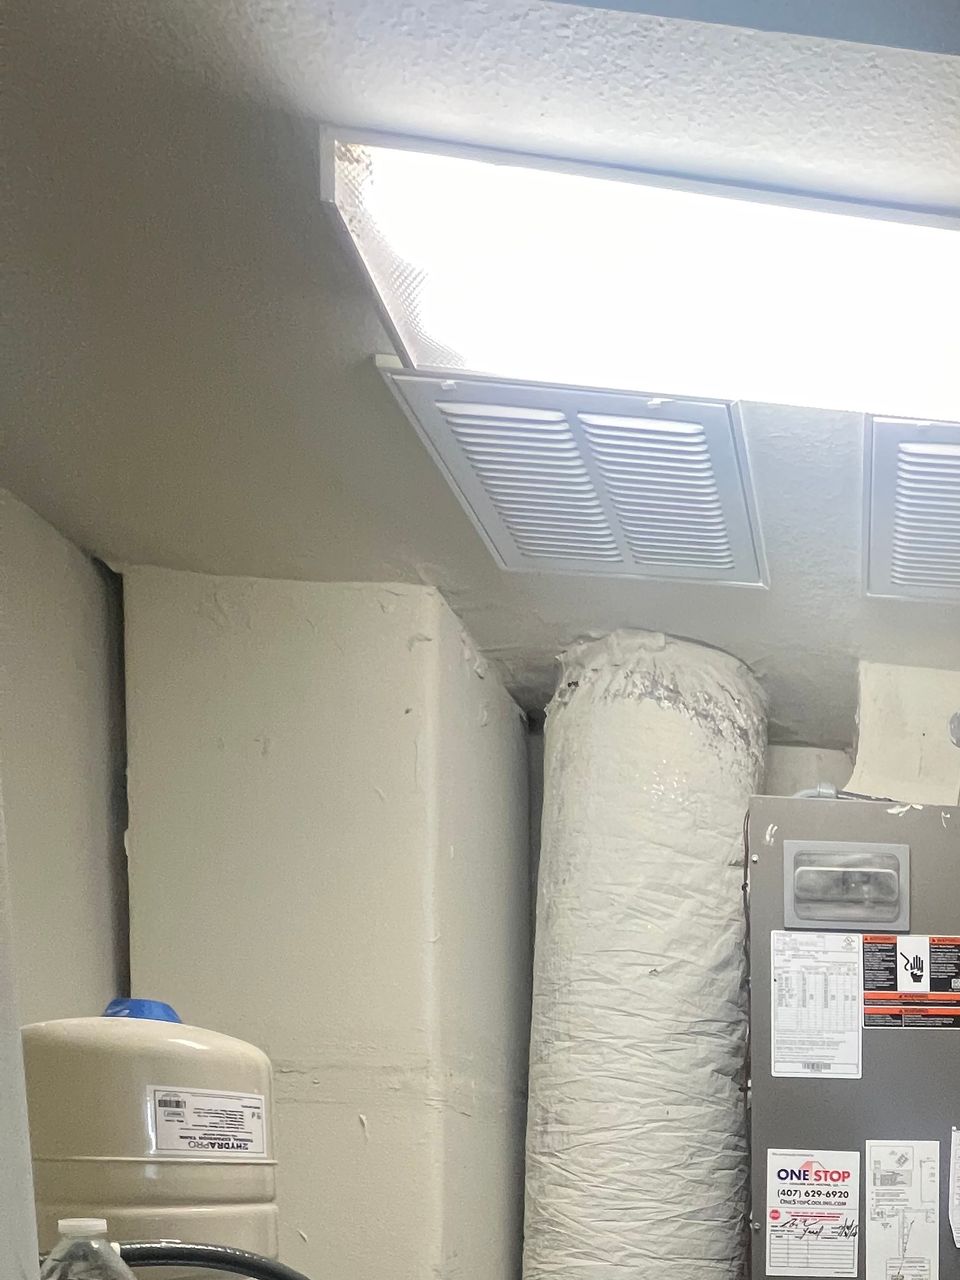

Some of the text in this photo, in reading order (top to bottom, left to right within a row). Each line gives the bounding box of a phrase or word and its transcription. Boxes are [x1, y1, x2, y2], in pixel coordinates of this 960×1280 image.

[777, 1168, 851, 1183] ONE STOP
[777, 1189, 849, 1199] (407) 629-6920
